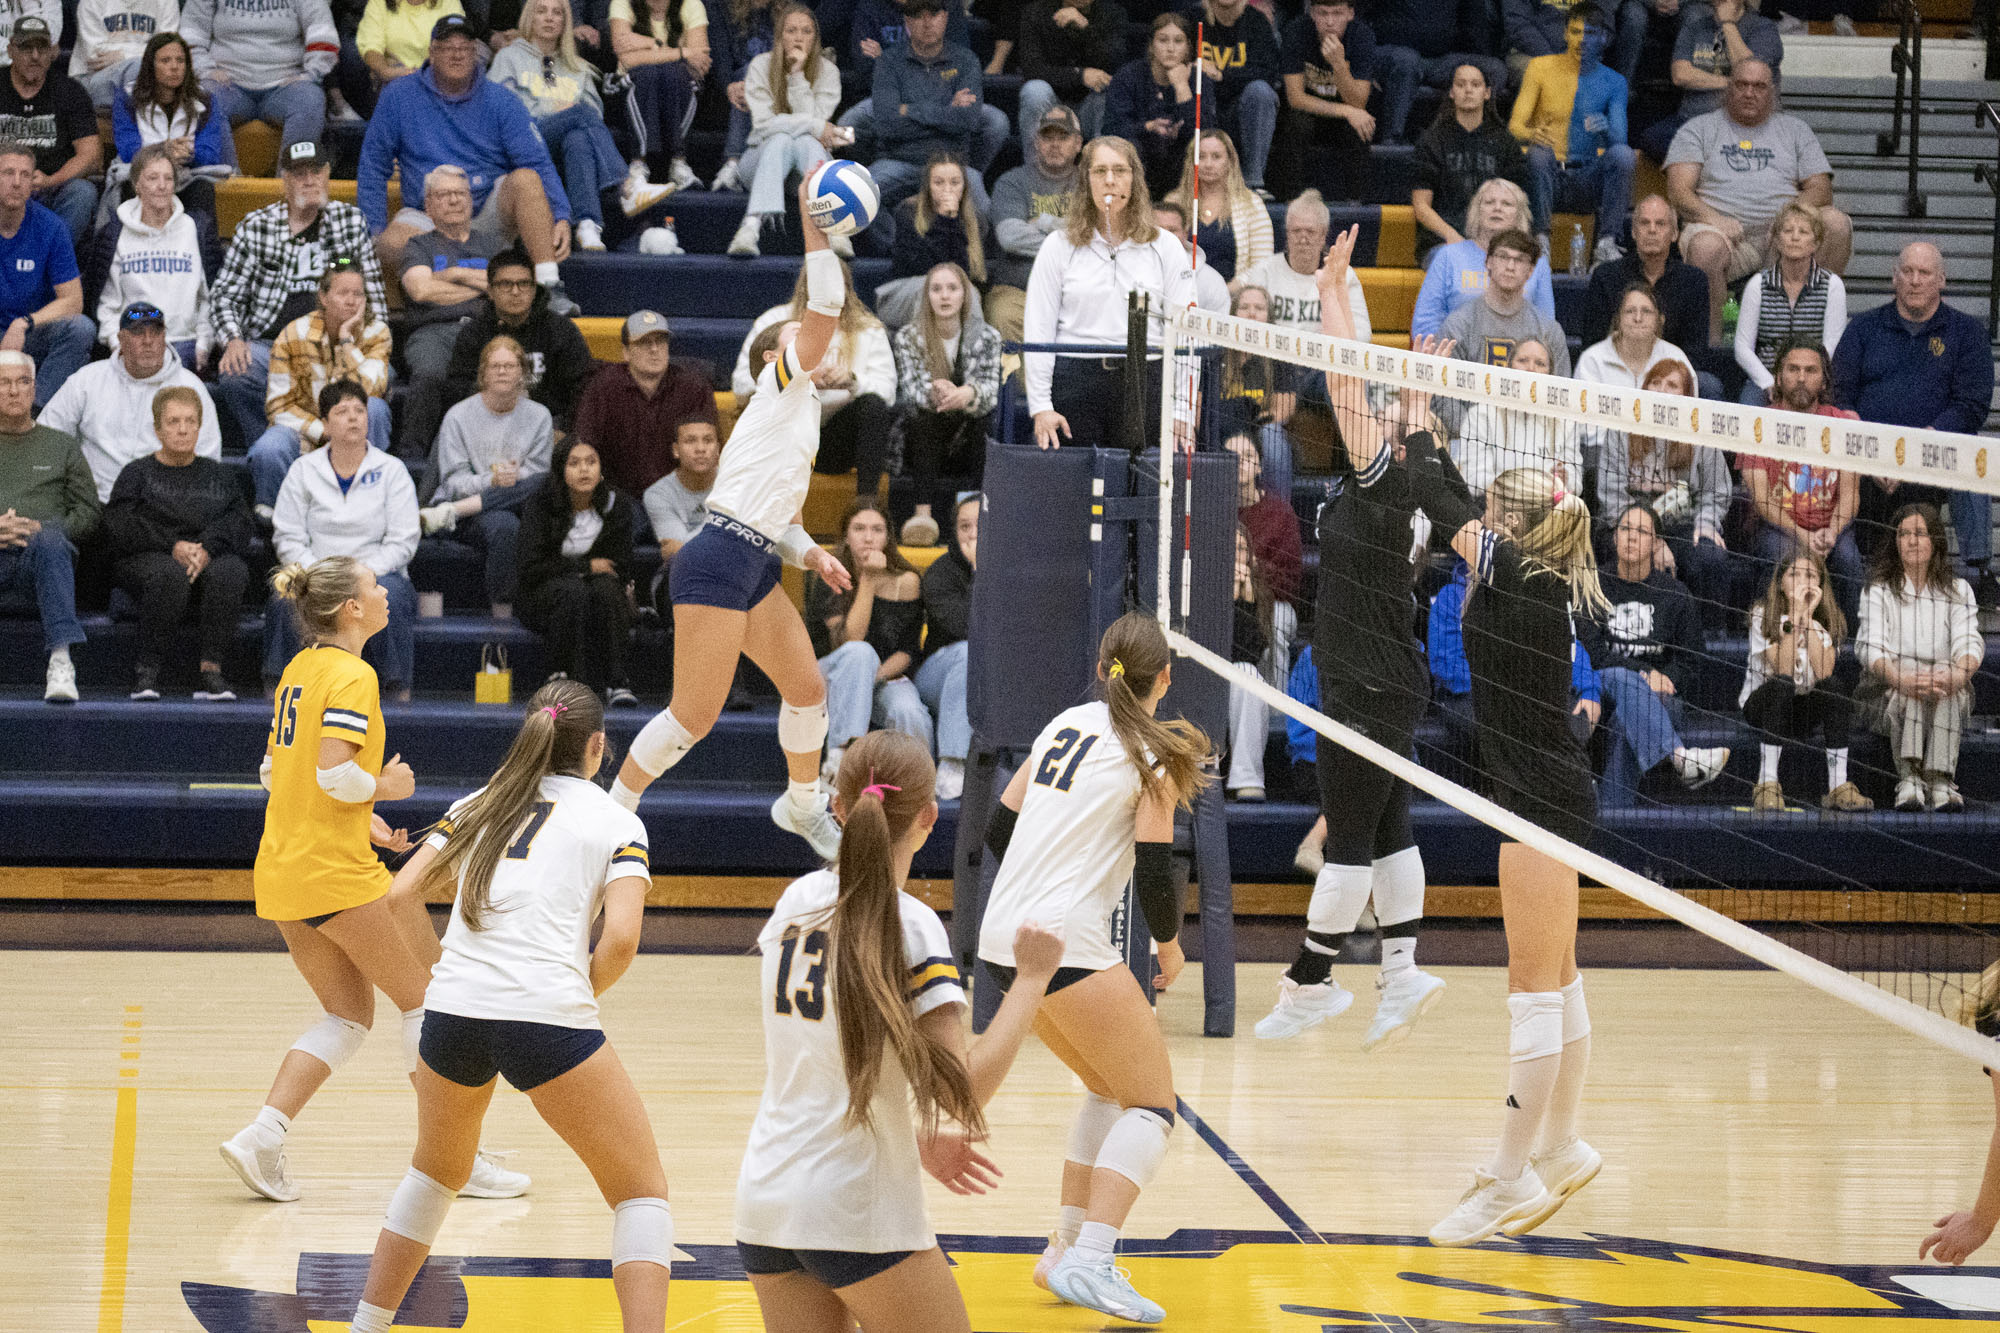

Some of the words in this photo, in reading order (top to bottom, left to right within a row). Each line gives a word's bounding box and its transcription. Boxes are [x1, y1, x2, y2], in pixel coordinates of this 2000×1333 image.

[1846, 432, 1863, 456] BUENA
[1865, 435, 1879, 459] VISTA
[1922, 443, 1940, 468] BUENA
[1942, 445, 1957, 471] VISTA
[724, 521, 764, 547] PRO
[275, 684, 304, 748] 15
[1034, 726, 1100, 792] 21
[775, 922, 829, 1024] 13
